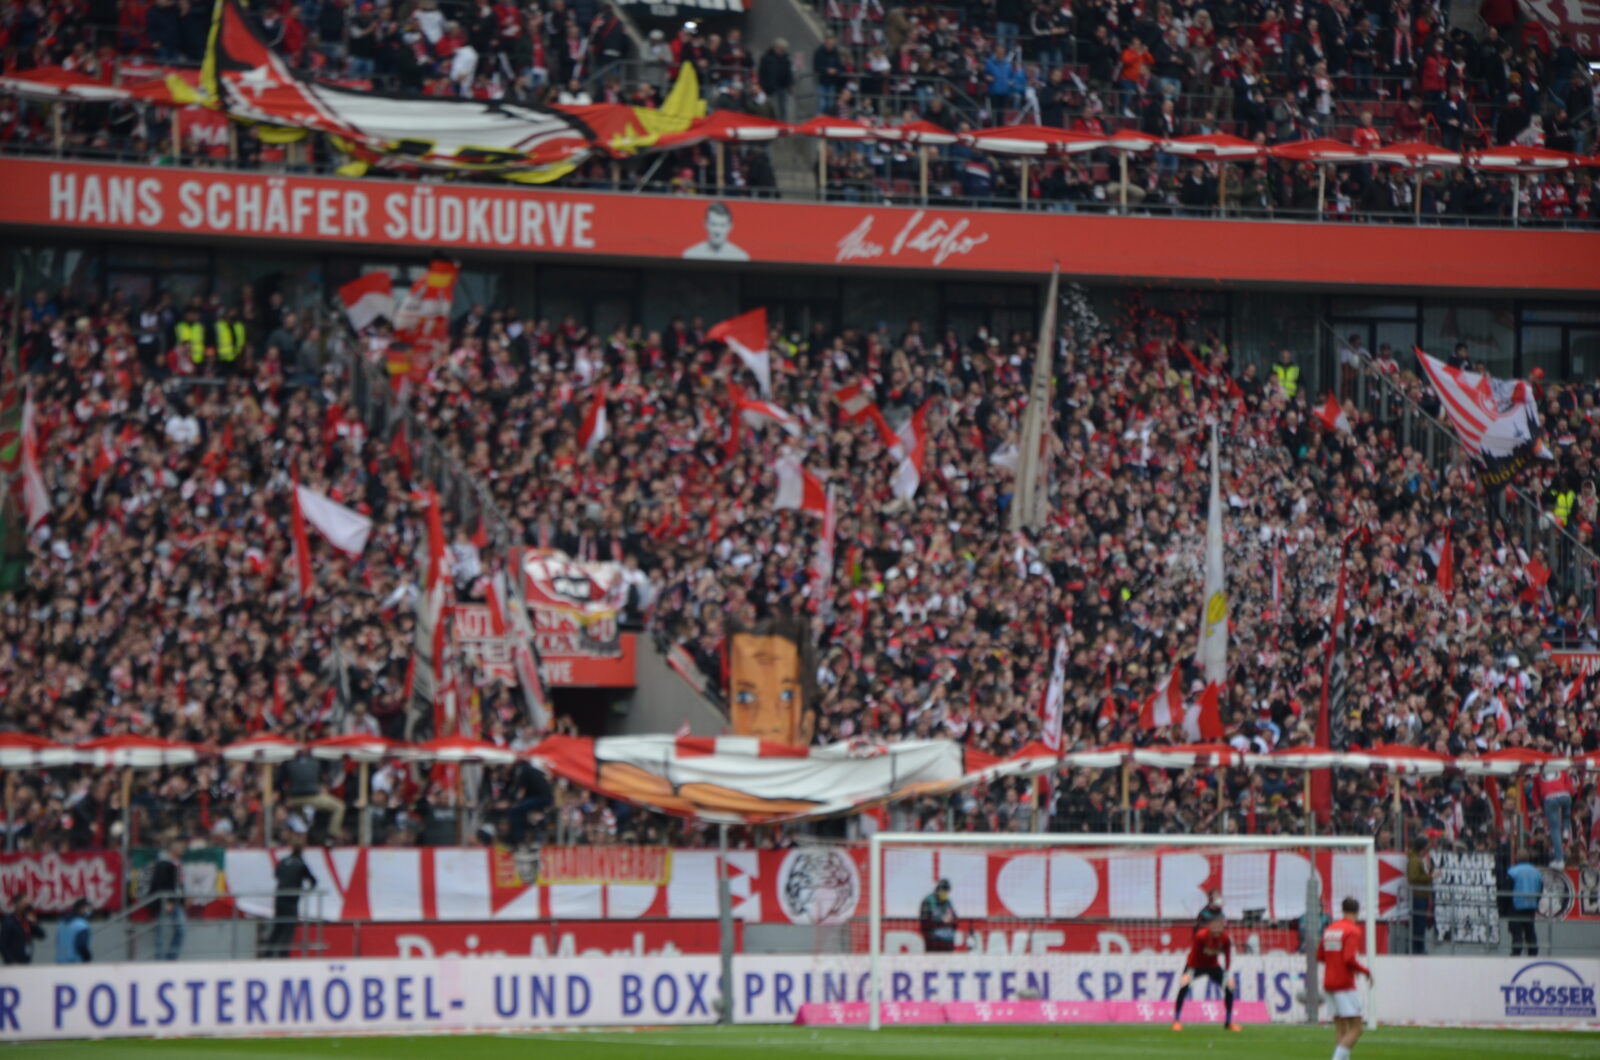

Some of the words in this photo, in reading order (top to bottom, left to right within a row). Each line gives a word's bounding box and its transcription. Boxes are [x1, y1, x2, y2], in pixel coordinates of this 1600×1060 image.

[50, 172, 163, 226] HANS
[178, 176, 368, 237] SCHÄFER
[384, 186, 595, 248] SÜDKURVE
[54, 964, 464, 1030] POLSTERMÖBEL-
[494, 974, 592, 1018] UND
[1500, 981, 1595, 1006] TRÖSSER
